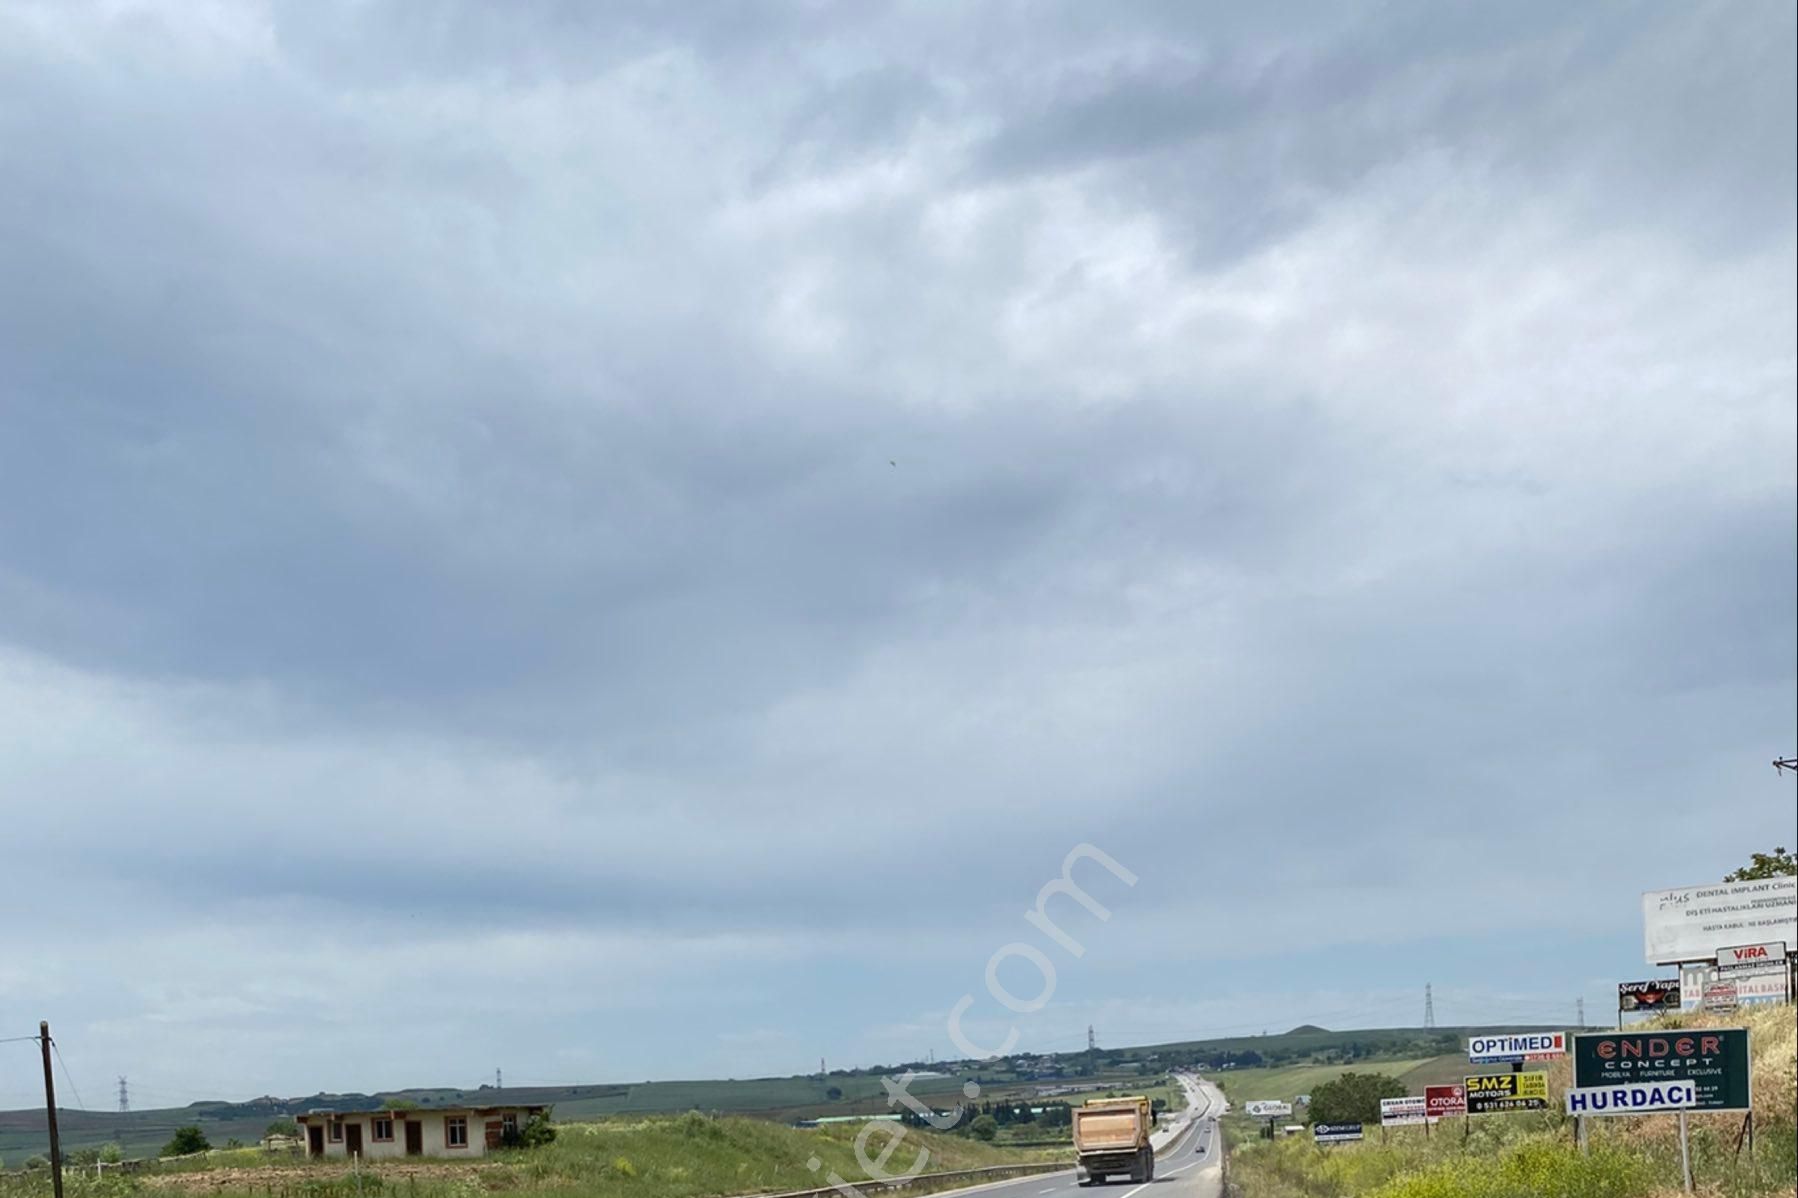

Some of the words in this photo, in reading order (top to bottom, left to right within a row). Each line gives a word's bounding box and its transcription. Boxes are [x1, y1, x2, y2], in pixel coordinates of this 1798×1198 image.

[1696, 889, 1728, 898] DENTAL
[1731, 884, 1770, 894] IMPLANT
[1597, 1035, 1720, 1059] ENDER
[1605, 1058, 1713, 1069] CONCEPT
[1688, 1067, 1722, 1076] EXCLUSIVE
[1467, 1076, 1512, 1091] SMZ
[1469, 1090, 1511, 1098] MOTORS
[1570, 1086, 1692, 1111] HURDACI
